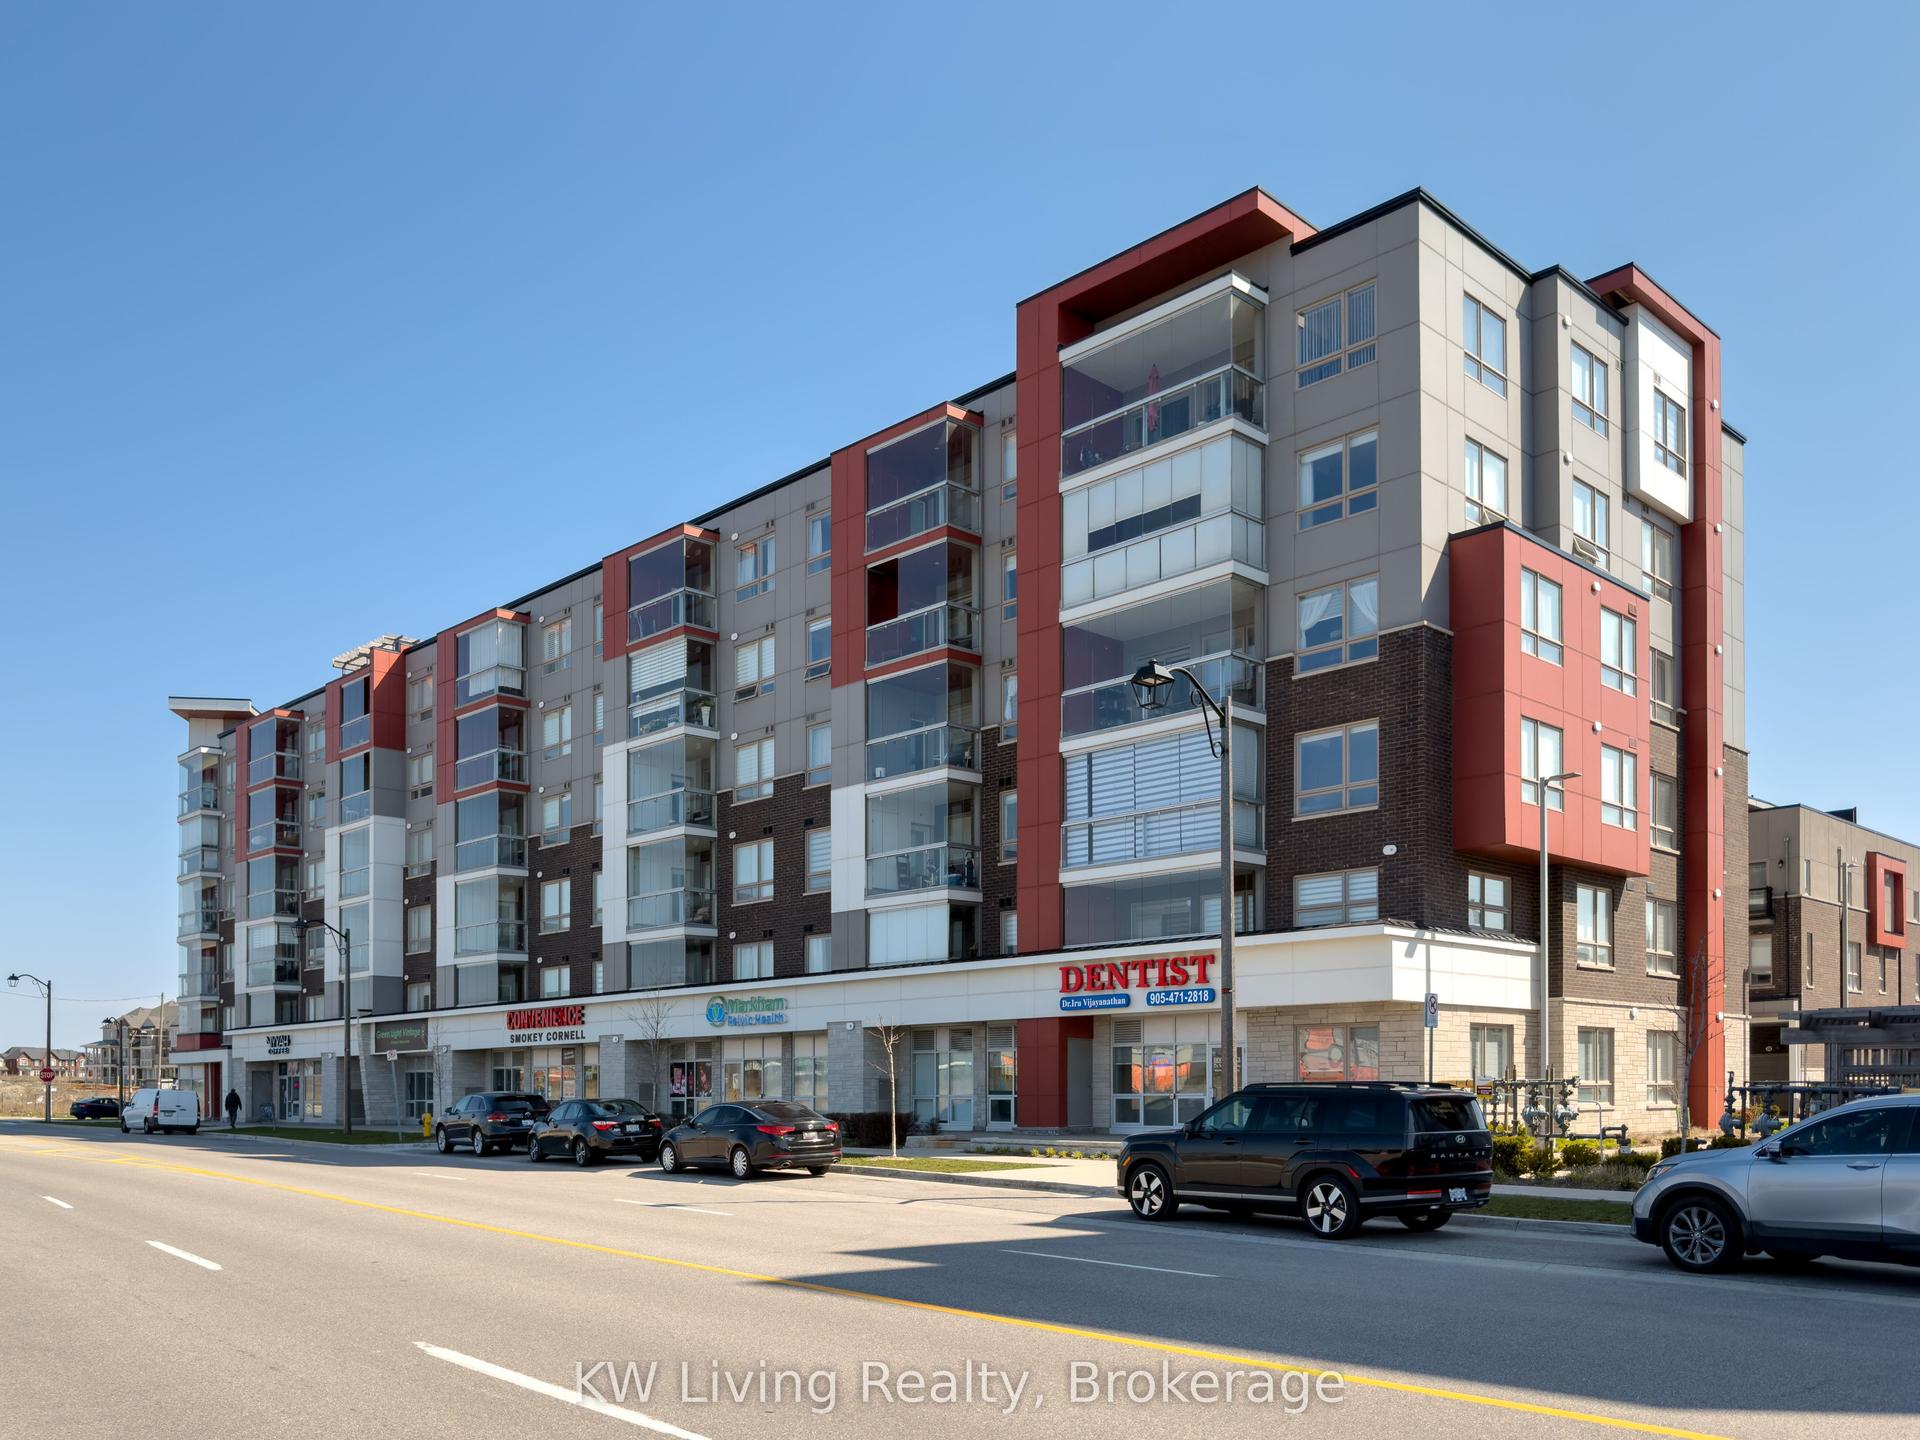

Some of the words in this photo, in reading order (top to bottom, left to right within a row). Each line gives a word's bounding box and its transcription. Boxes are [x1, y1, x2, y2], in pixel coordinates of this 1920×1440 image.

[1059, 954, 1215, 993] DENTIST
[1083, 998, 1126, 1008] Vijayanathan
[1150, 990, 1209, 1004] 905-471-2818
[728, 996, 787, 1014] Markham
[507, 1005, 585, 1030] CONVENIENCE
[510, 1033, 543, 1044] SMOKEY
[546, 1030, 585, 1042] CORNELL
[40, 1071, 55, 1079] STOP
